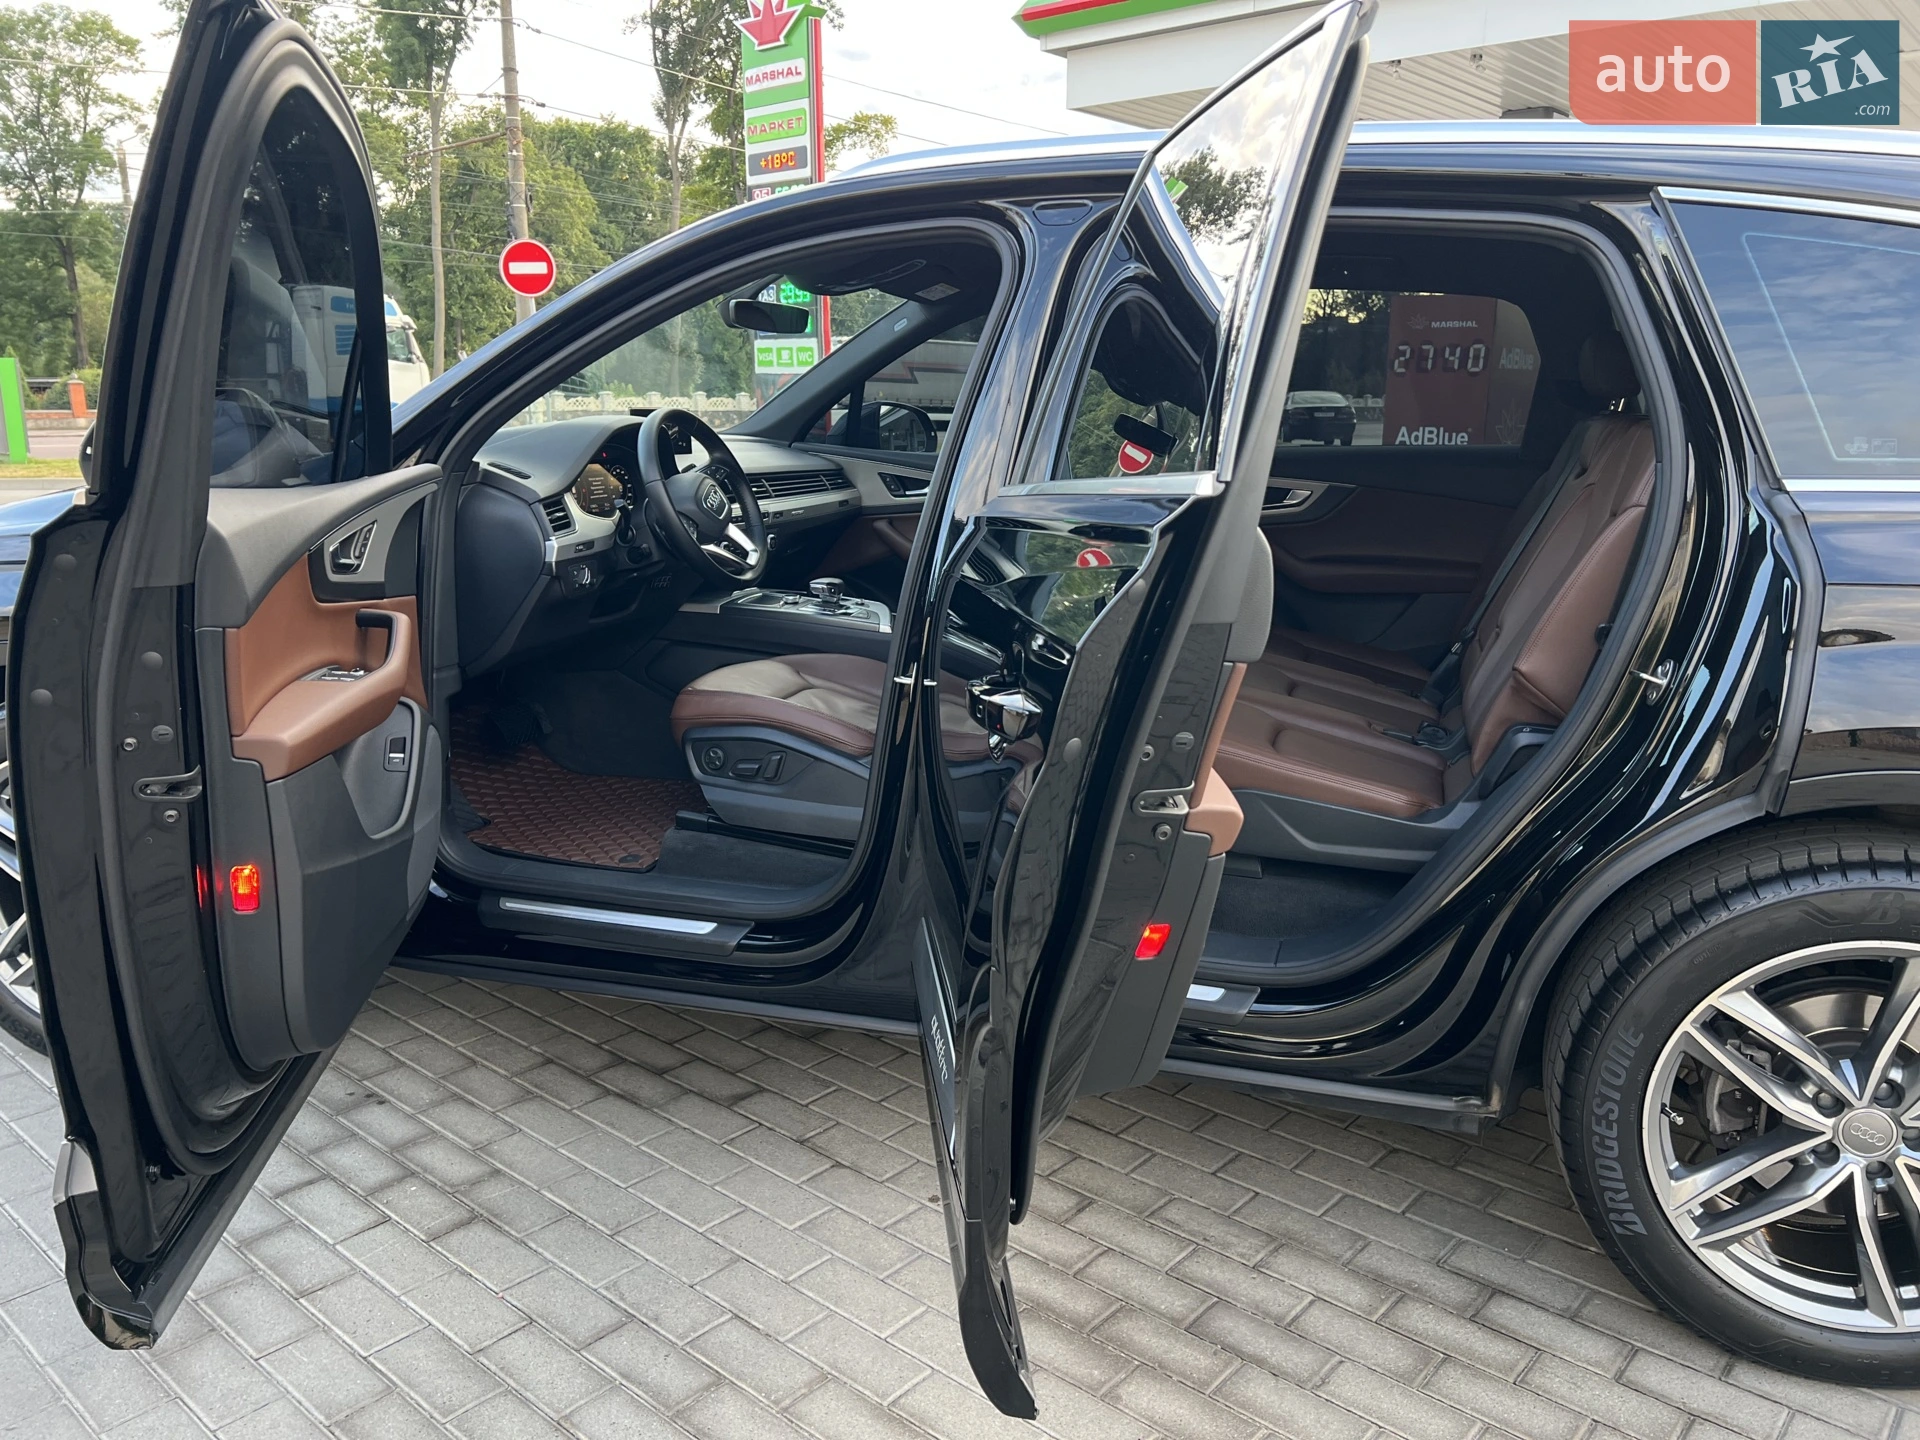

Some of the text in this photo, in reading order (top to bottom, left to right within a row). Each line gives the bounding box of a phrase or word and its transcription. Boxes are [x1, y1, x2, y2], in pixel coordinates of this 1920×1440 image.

[745, 65, 802, 87] MARSHAL
[758, 351, 813, 362] VISA WC
[1499, 348, 1534, 370] AdBlue
[1394, 426, 1469, 446] AdBlue
[1592, 1024, 1648, 1236] BRIDGESTONE
